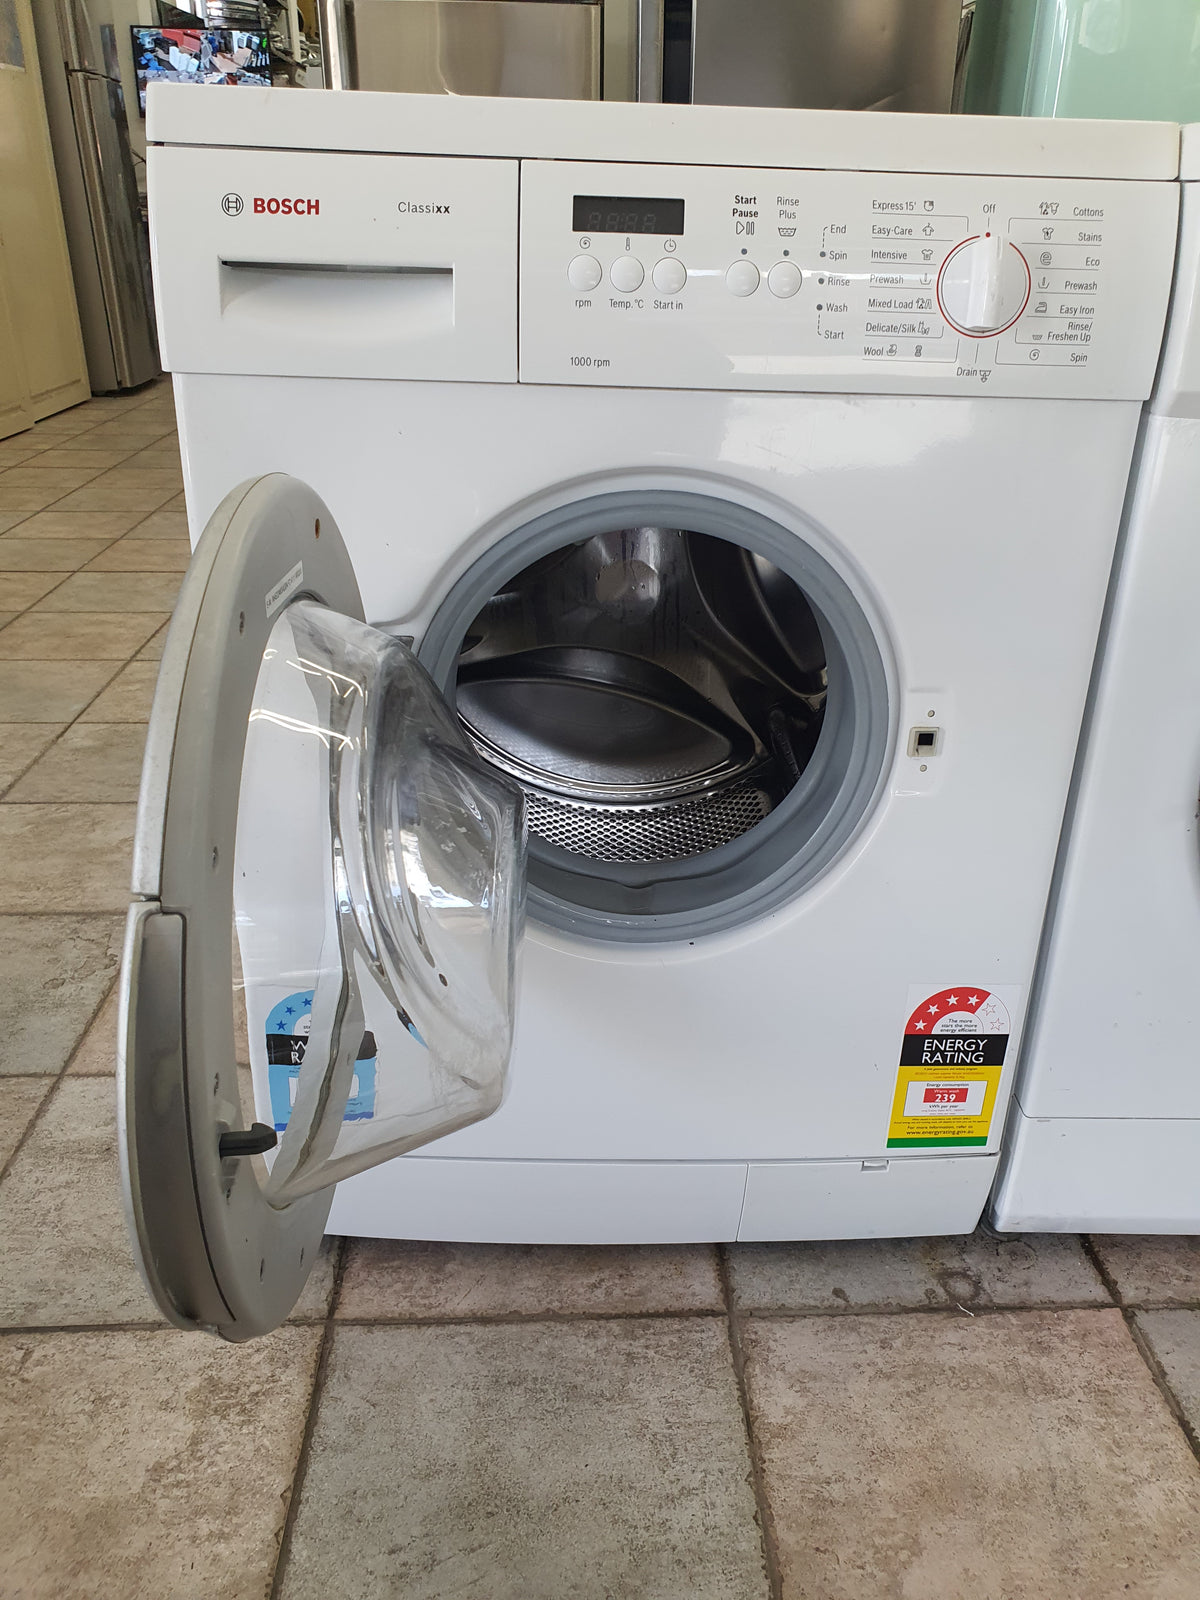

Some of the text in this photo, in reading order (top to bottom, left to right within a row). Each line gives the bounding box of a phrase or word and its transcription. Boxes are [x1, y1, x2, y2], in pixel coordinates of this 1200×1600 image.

[734, 195, 757, 205] Start
[776, 196, 800, 207] Rinse
[872, 200, 904, 211] Express
[253, 197, 320, 216] BOSCH
[397, 200, 450, 214] Classixx
[982, 203, 996, 214] Off
[1073, 206, 1104, 217] Cottons
[732, 208, 759, 218] Pause
[779, 210, 797, 220] Plus
[830, 224, 847, 234] End
[1078, 232, 1102, 242] Stains
[829, 250, 848, 261] Spin
[871, 250, 908, 260] Intensive
[1085, 257, 1100, 267] Eco
[827, 276, 850, 287] Rinse
[869, 274, 904, 284] Prewash
[1064, 280, 1098, 291] Prewash
[575, 299, 592, 308] rpm
[609, 298, 634, 310] Temp.
[653, 300, 684, 310] Start in
[826, 303, 848, 313] Wash
[868, 298, 913, 309] Mixed Load
[1059, 304, 1095, 316] Easy Iron
[865, 322, 916, 334] Delicate/Silk
[1067, 321, 1093, 332] Rinse/
[824, 330, 844, 340] Start
[1047, 332, 1091, 344] Freshen Up
[863, 346, 884, 356] Wool
[570, 356, 610, 369] 1000 rpm
[1070, 352, 1088, 364] Spin
[956, 367, 978, 377] Drain
[923, 1039, 988, 1051] ENERGY
[921, 1052, 985, 1064] RATING
[934, 1094, 956, 1103] 239
